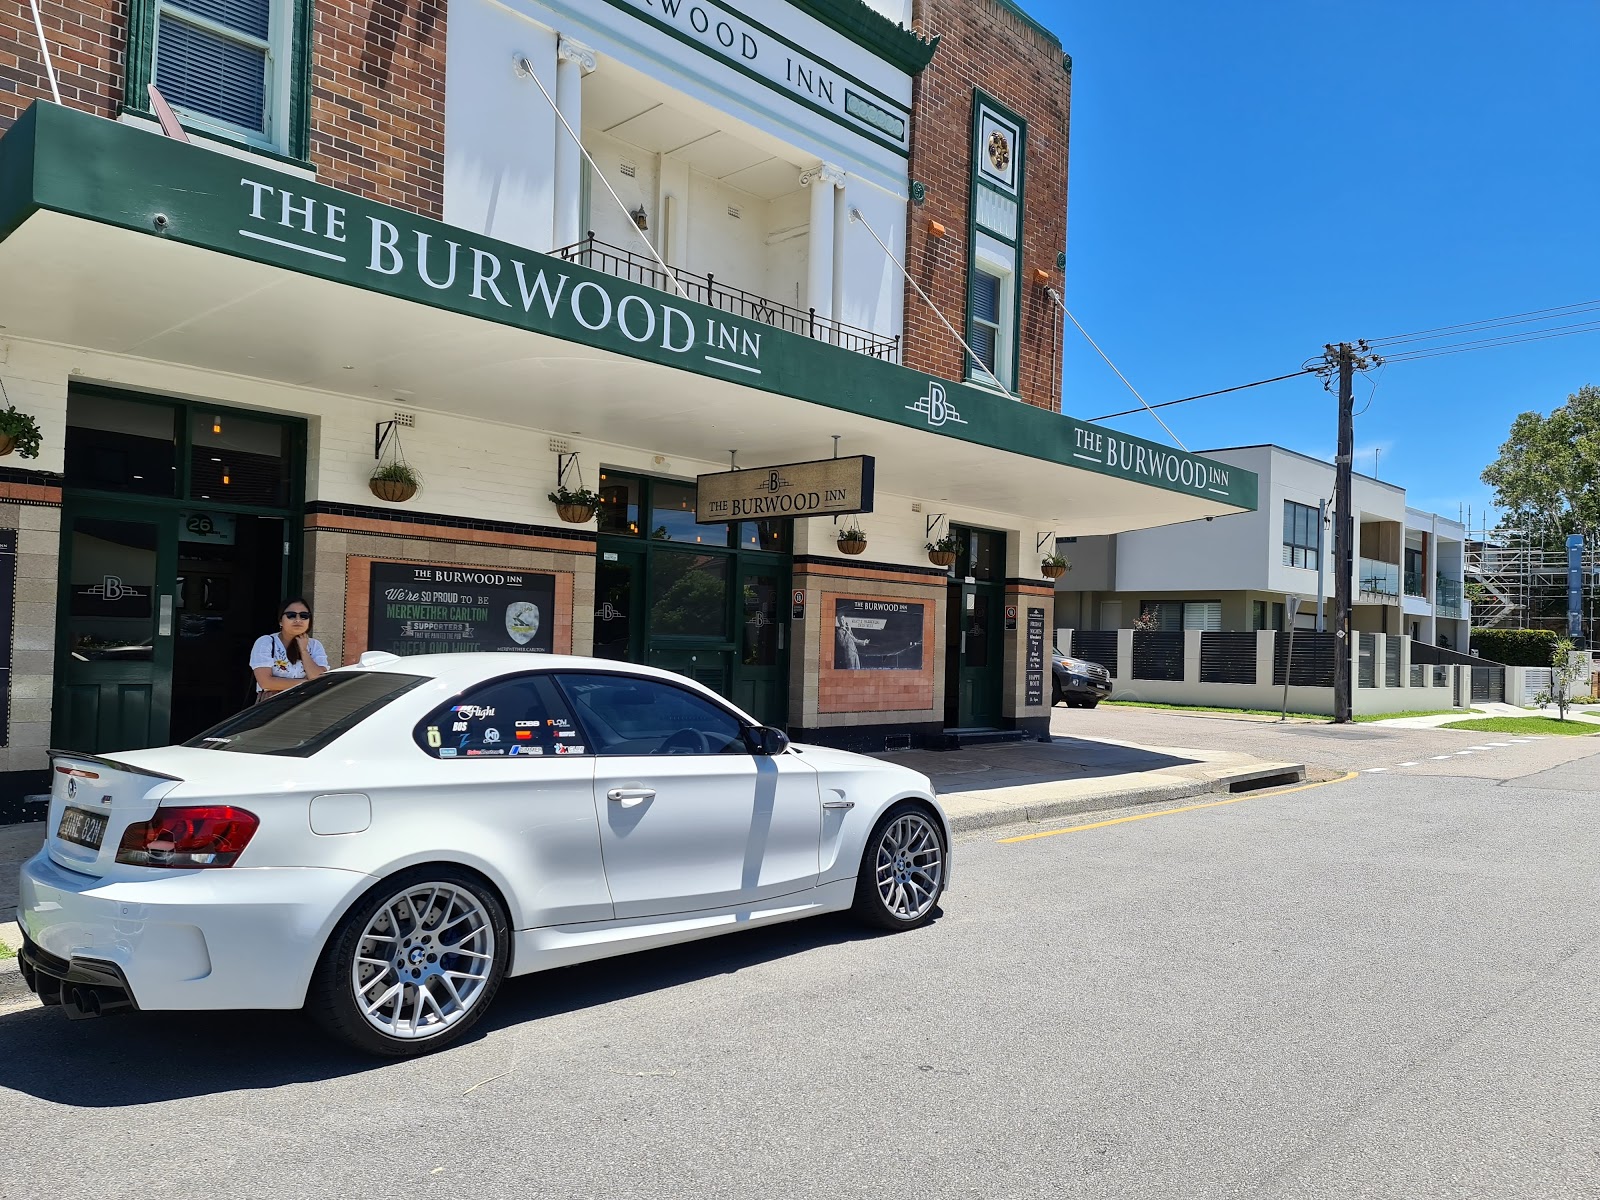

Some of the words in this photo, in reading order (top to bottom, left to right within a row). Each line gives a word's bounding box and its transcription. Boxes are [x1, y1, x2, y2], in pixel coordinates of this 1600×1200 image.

[646, 0, 758, 60] WOOD
[787, 58, 834, 104] INN
[240, 178, 346, 242] THE
[365, 215, 695, 353] BURWOOD
[706, 318, 761, 359] INN
[1074, 427, 1102, 453] THE
[1106, 437, 1207, 488] BURWOOD
[1209, 466, 1229, 486] INN
[709, 501, 728, 512] THE
[731, 493, 820, 516] BURWOOD
[825, 489, 847, 502] INN
[189, 518, 210, 531] 26
[414, 569, 431, 578] THE
[435, 570, 504, 585] BURWOOD
[507, 575, 522, 583] INN
[385, 588, 420, 602] We're
[421, 591, 432, 602] SO
[433, 591, 458, 603] PROUD
[461, 595, 473, 603] TO
[478, 596, 489, 605] BE
[386, 604, 448, 620] MEREWETHER
[449, 606, 488, 621] CARLTON
[864, 602, 898, 611] BURWOOD
[413, 622, 462, 631] SUPPORTERS
